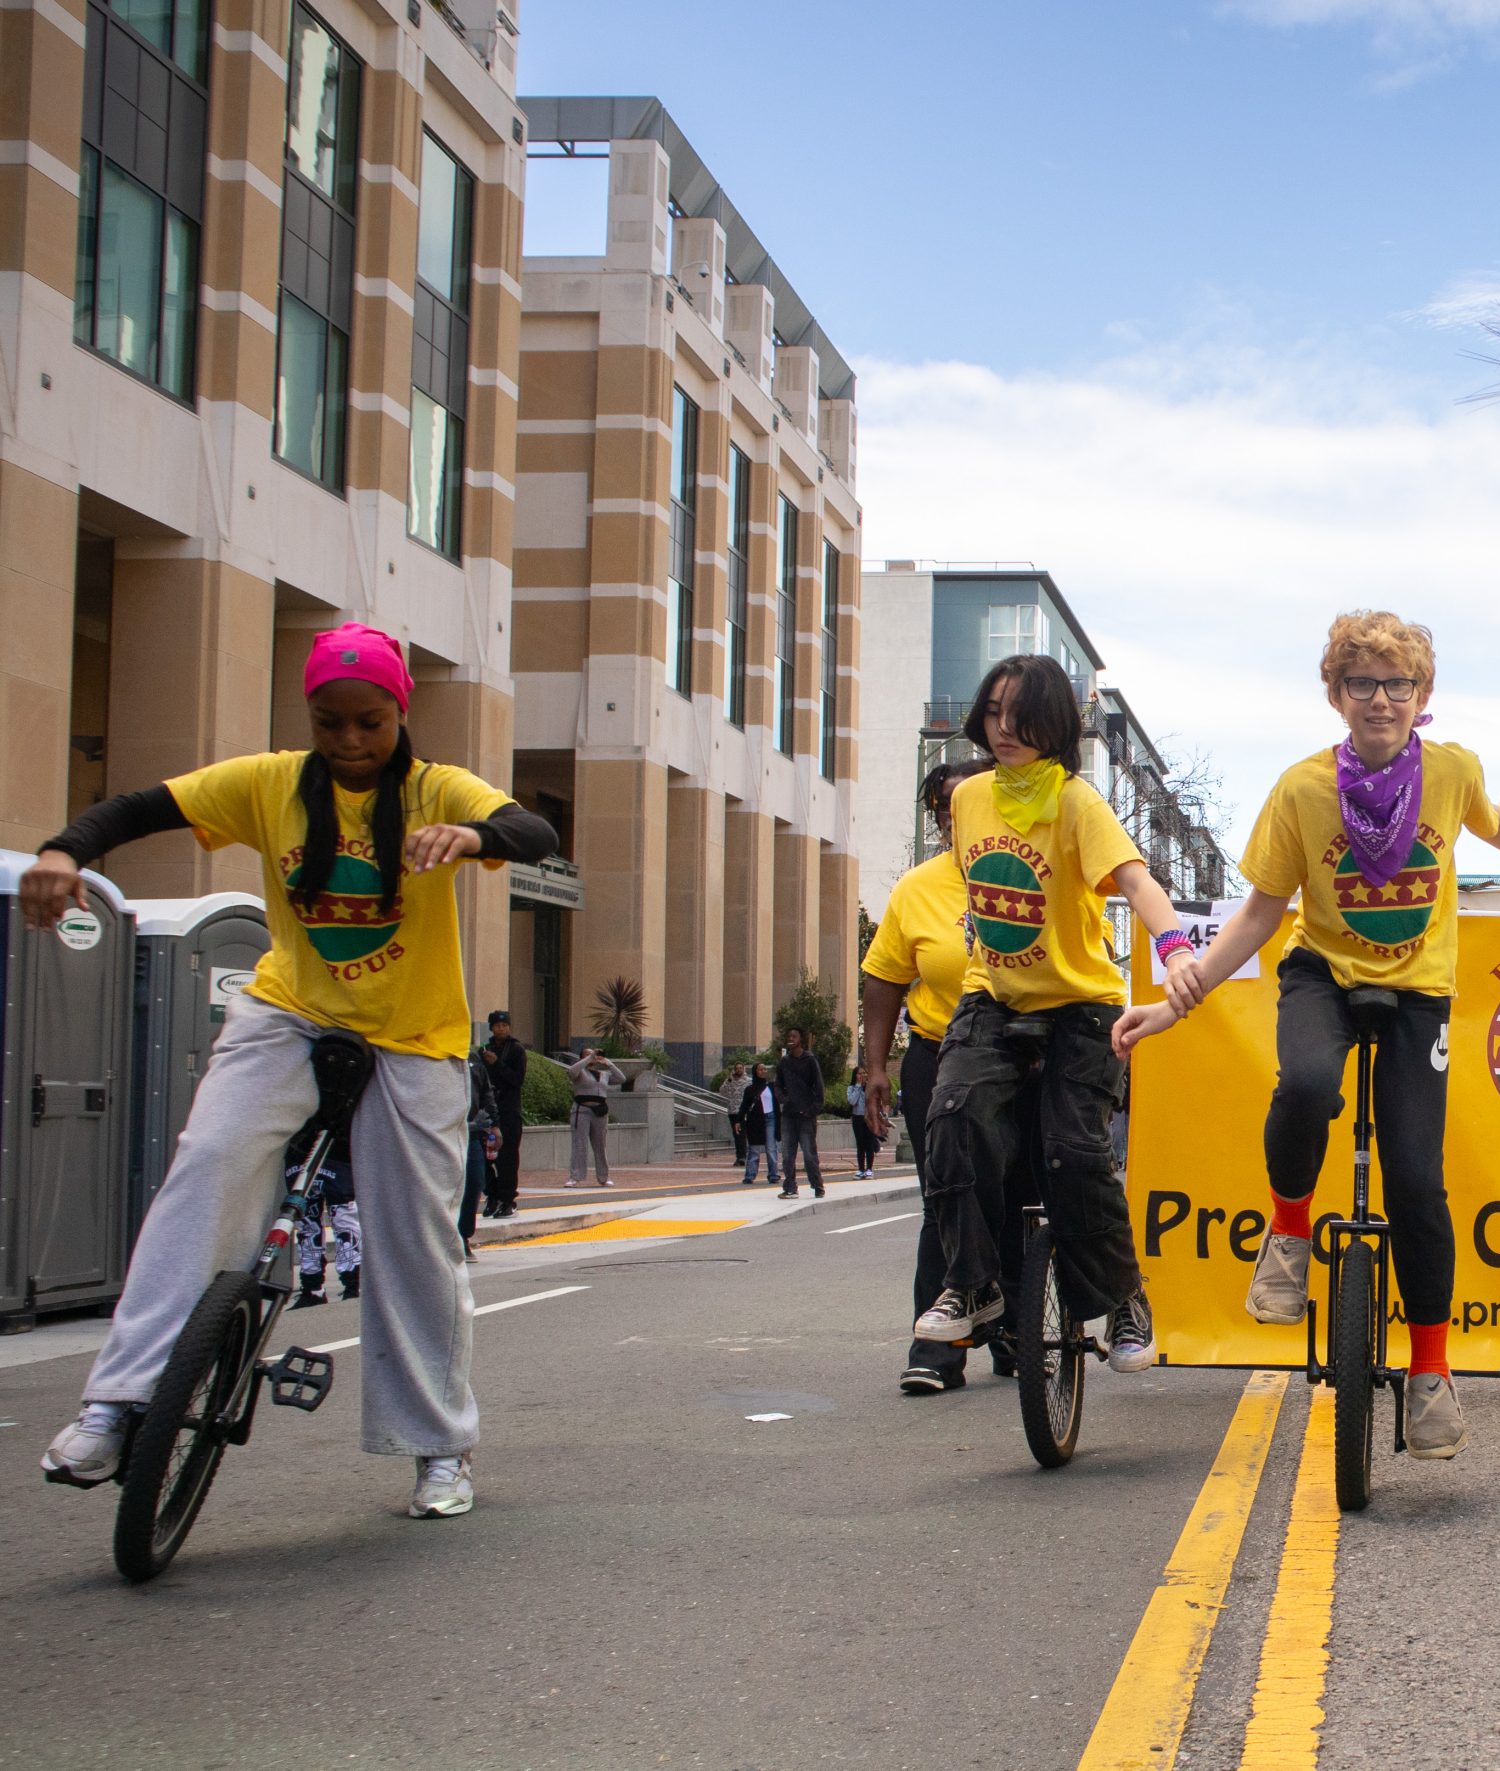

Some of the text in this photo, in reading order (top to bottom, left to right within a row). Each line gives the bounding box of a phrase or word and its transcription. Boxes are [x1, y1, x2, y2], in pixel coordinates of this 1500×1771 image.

[1321, 823, 1446, 869] PRTT
[325, 940, 405, 982] RCUS
[981, 945, 1047, 969] RCUS
